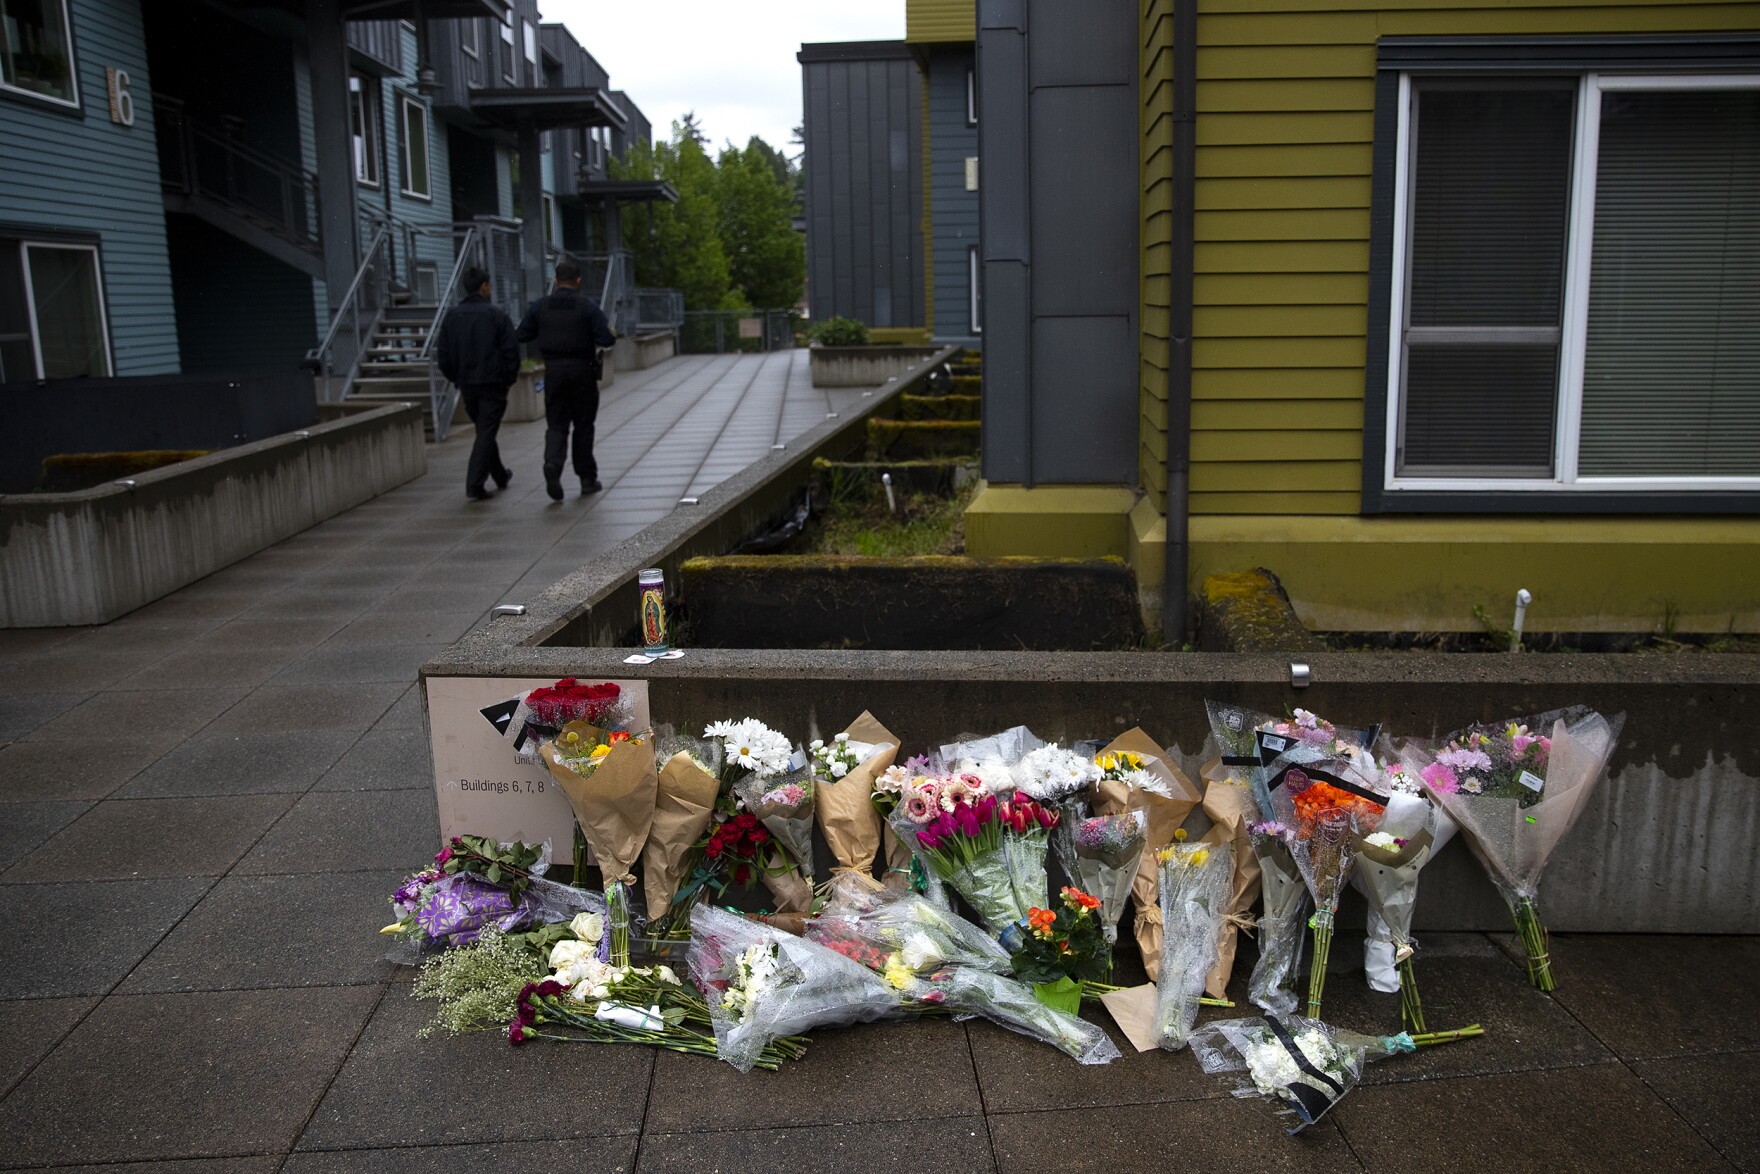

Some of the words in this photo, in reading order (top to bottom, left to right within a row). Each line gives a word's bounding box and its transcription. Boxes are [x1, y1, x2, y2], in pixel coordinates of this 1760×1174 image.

[115, 69, 134, 126] 6
[460, 779, 509, 794] Buildings
[512, 780, 523, 794] 6,
[525, 780, 535, 794] 7,
[537, 780, 545, 793] 8
